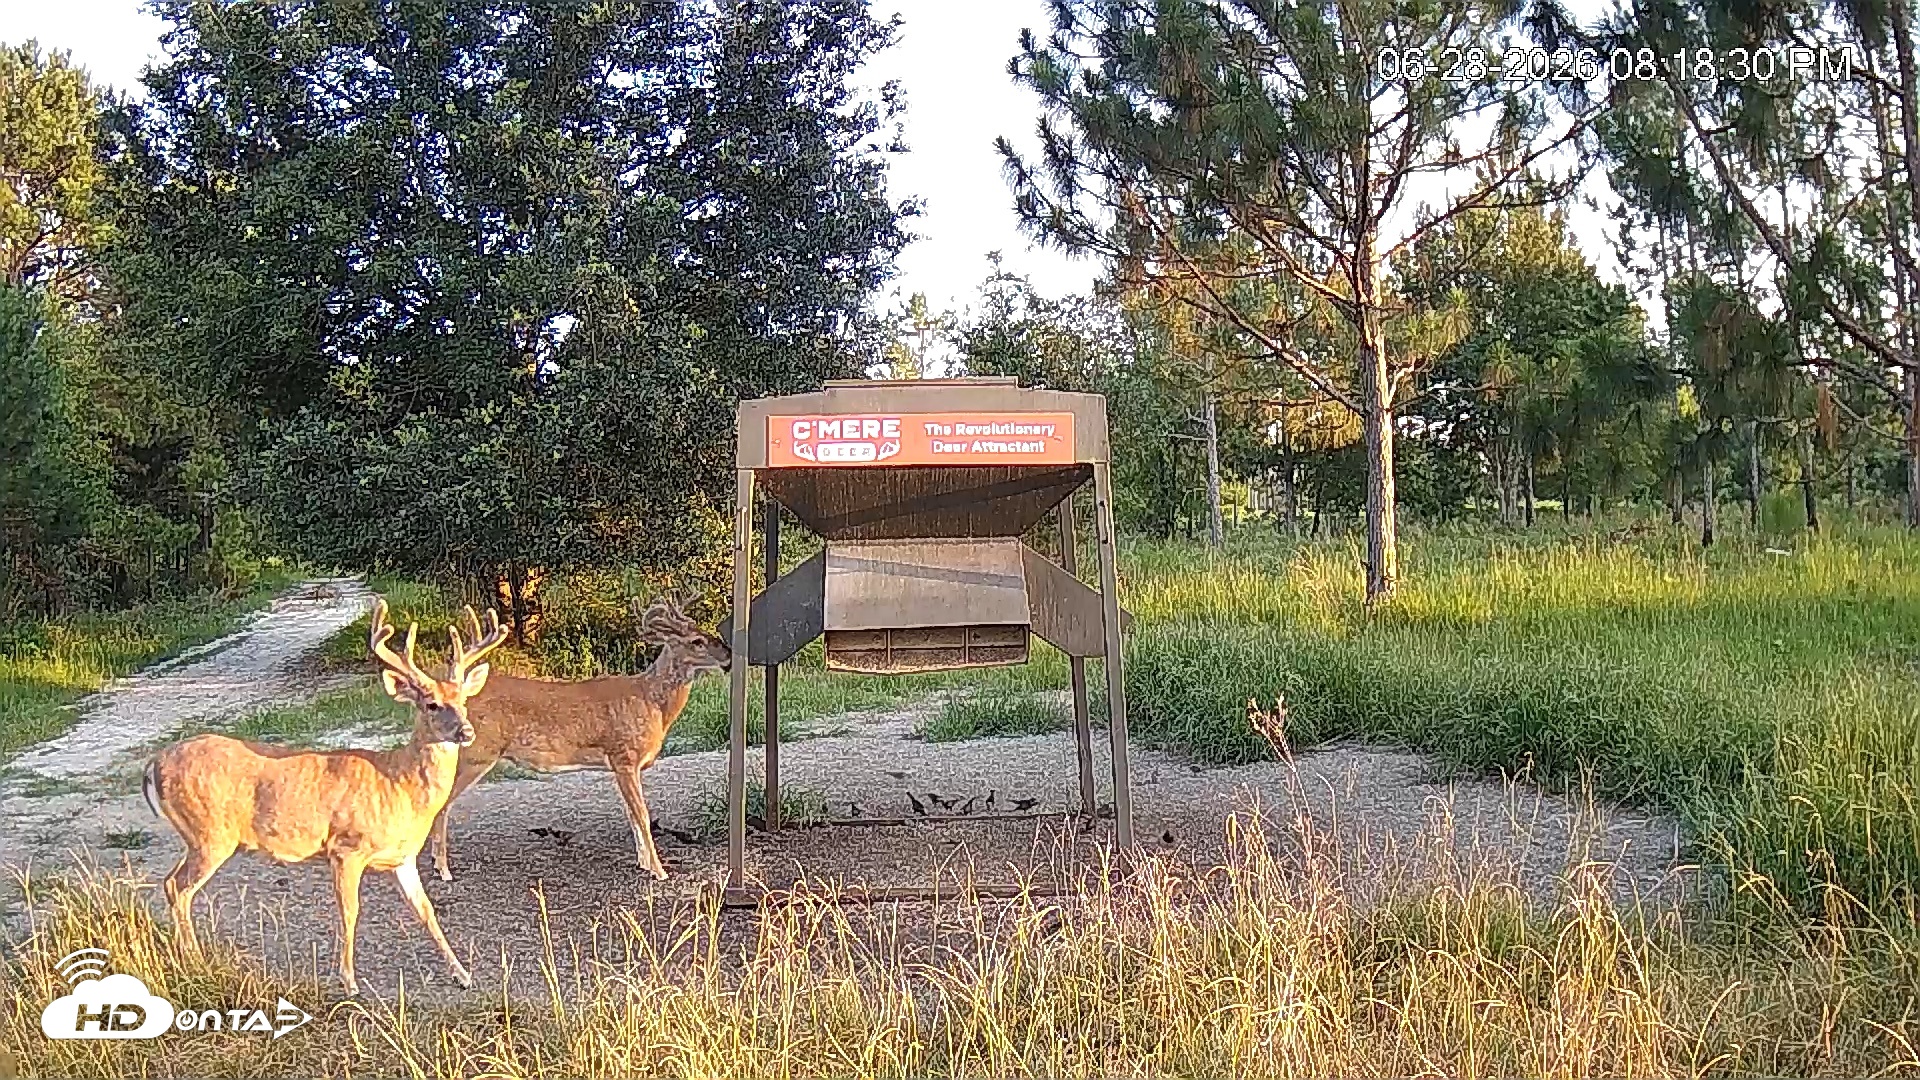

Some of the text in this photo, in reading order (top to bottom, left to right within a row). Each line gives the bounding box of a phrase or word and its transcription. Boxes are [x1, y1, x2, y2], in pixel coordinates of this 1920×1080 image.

[792, 419, 901, 439] C'MERE
[924, 422, 1055, 437] The Revolutionary
[933, 440, 1045, 453] Deer Attractant
